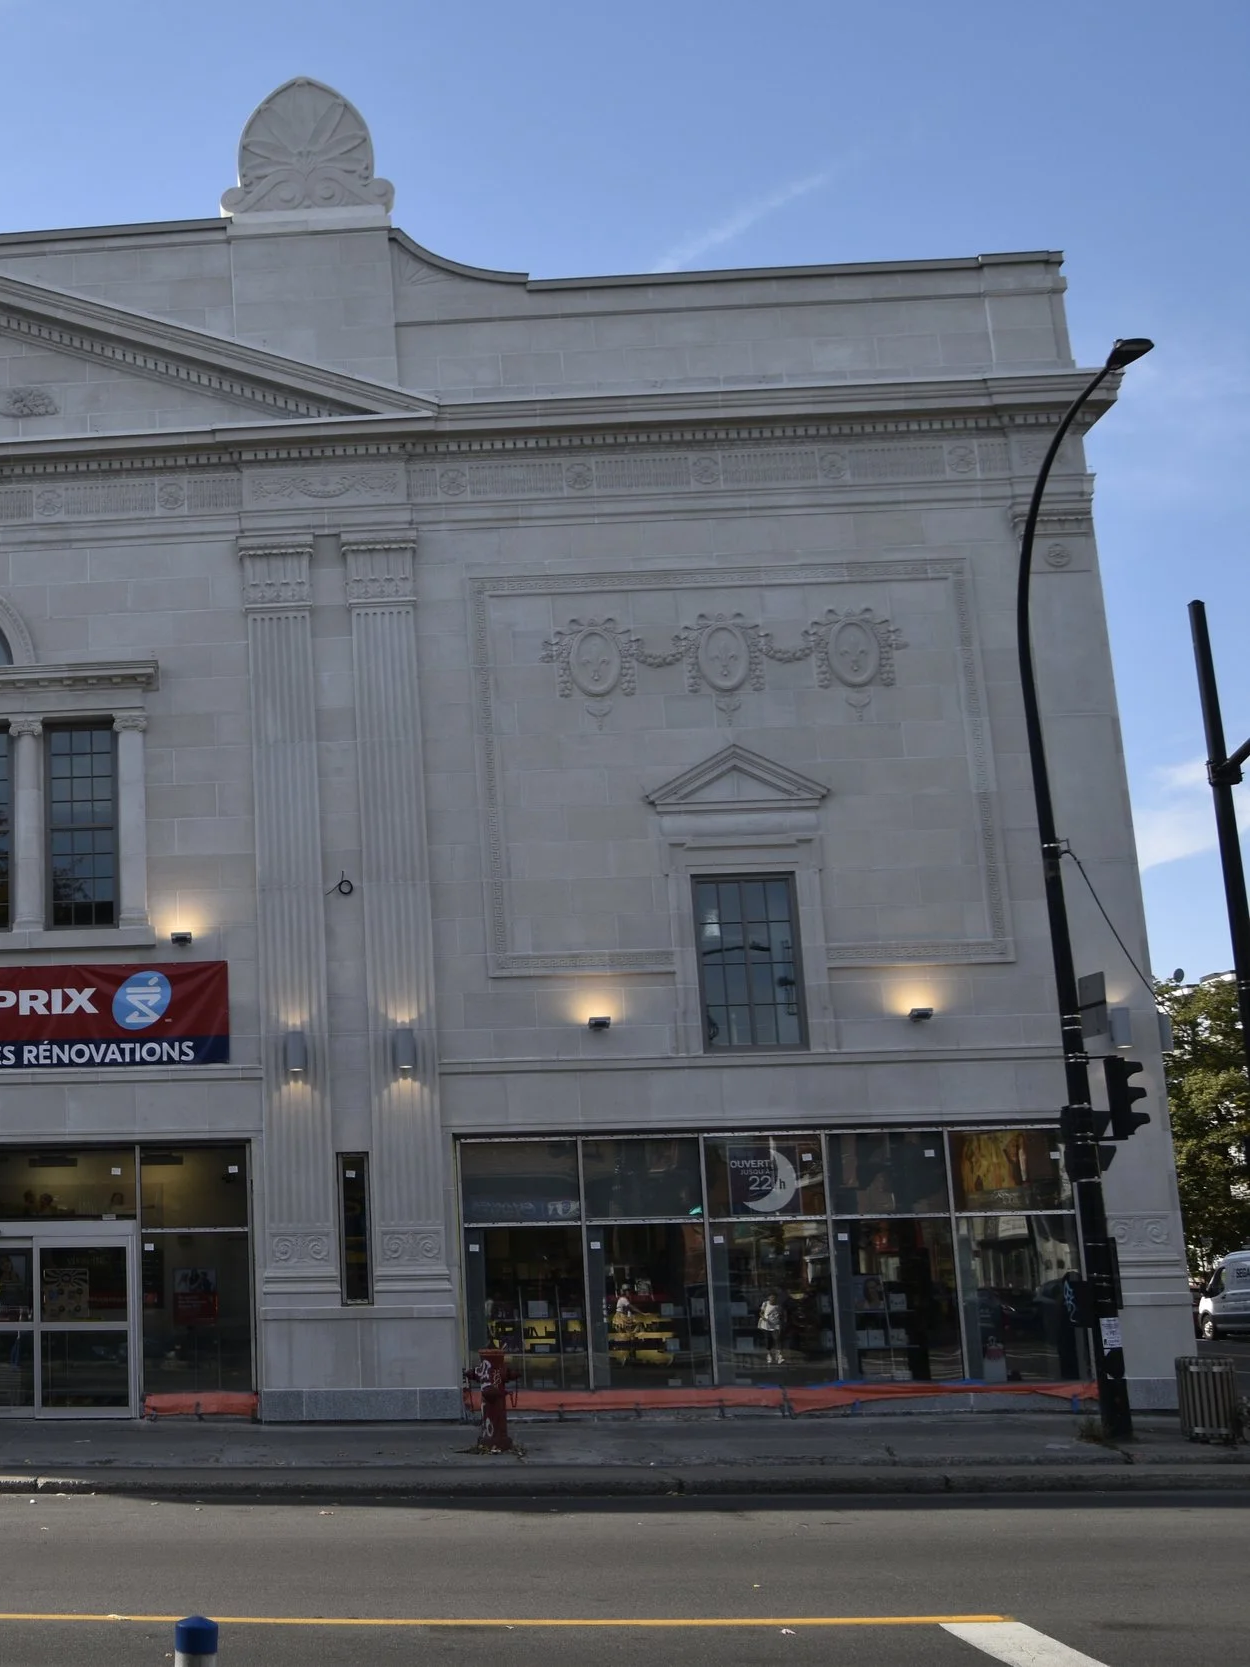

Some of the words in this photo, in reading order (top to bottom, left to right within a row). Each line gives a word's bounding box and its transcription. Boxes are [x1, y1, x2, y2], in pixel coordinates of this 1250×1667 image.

[23, 1040, 194, 1065] RÉNOVATIONS
[730, 1159, 770, 1169] OUVERT
[749, 1175, 772, 1190] 22
[779, 1179, 786, 1190] h
